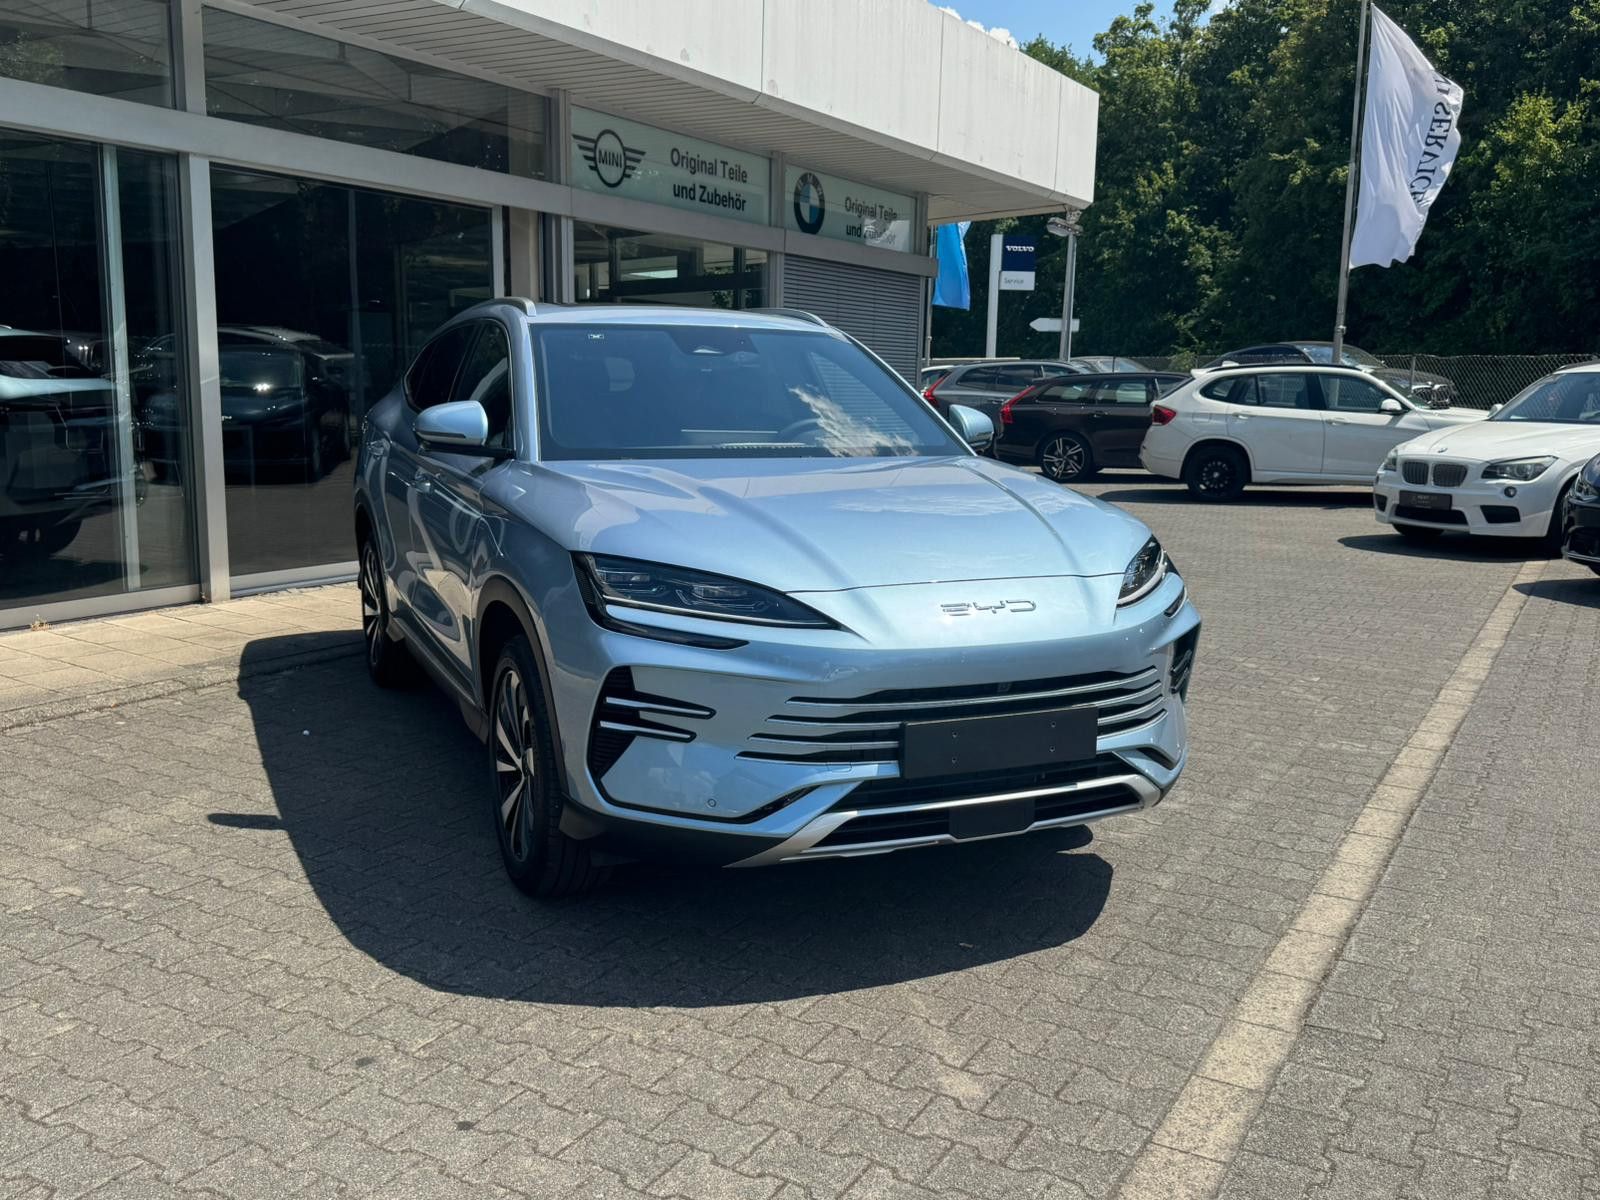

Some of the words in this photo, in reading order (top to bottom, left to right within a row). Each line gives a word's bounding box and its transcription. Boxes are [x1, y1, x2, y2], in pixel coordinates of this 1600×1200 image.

[598, 149, 622, 168] MINI
[671, 147, 718, 175] Original
[720, 160, 748, 183] Teile
[673, 184, 696, 201] und
[699, 184, 747, 212] Zubehör
[845, 196, 877, 218] Original
[878, 205, 898, 221] Teile
[846, 224, 862, 238] und
[1004, 277, 1025, 285] Service
[940, 598, 1037, 617] BYD
